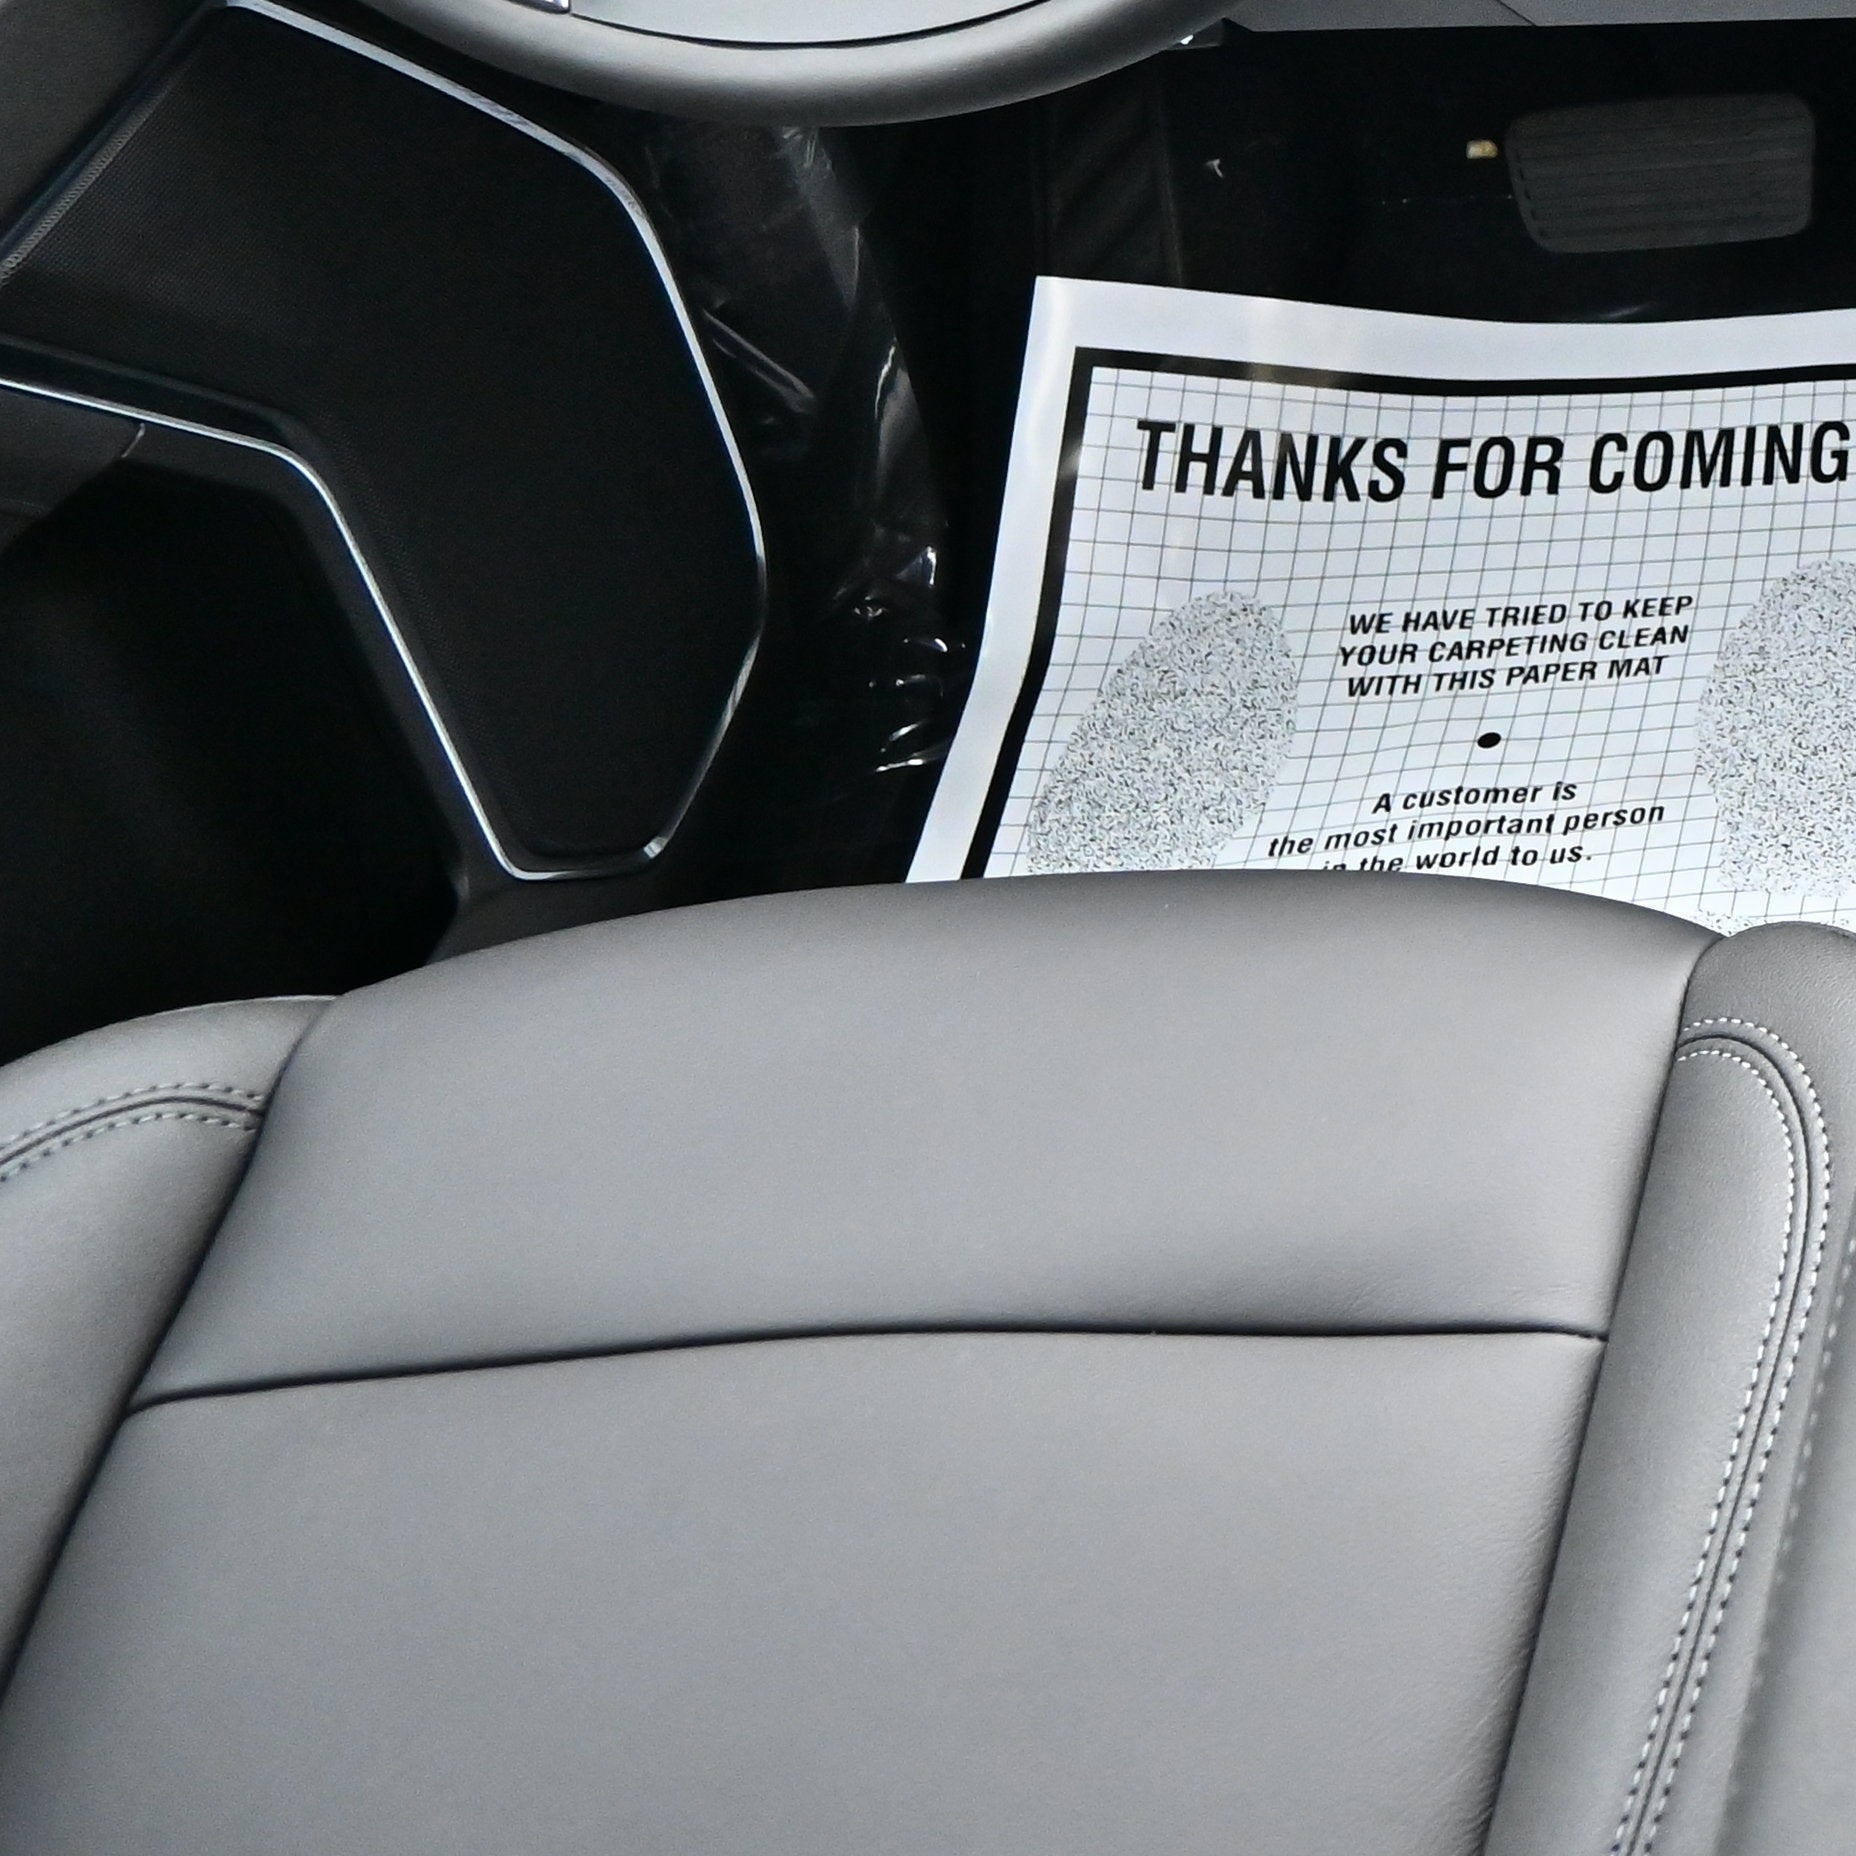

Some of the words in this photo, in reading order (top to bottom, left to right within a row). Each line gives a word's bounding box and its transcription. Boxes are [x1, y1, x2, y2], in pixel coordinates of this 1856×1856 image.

[1136, 419, 1409, 503] THANKS
[1431, 435, 1565, 500] FOR
[1589, 420, 1851, 495] COMING
[1349, 612, 1393, 635] WE
[1402, 609, 1476, 633] HAVE
[1485, 603, 1567, 628] TRIED
[1578, 600, 1613, 622] TO
[1622, 595, 1693, 619] KEEP
[1339, 643, 1418, 667] YOUR
[1428, 632, 1588, 663] CARPETING
[1597, 624, 1690, 651] CLEAN
[1348, 673, 1423, 698] WITH
[1432, 668, 1495, 693] THIS
[1506, 660, 1598, 687] PAPER
[1607, 655, 1670, 679] MAT
[1372, 793, 1392, 814] A
[1402, 782, 1543, 811] customer
[1551, 781, 1578, 801] is
[1267, 835, 1313, 858] the
[1323, 823, 1399, 851] most
[1407, 813, 1555, 841] important
[1562, 804, 1665, 833] person
[1359, 854, 1402, 872] the
[1416, 845, 1500, 870] world
[1510, 845, 1538, 867] to
[1549, 844, 1593, 865] us.
